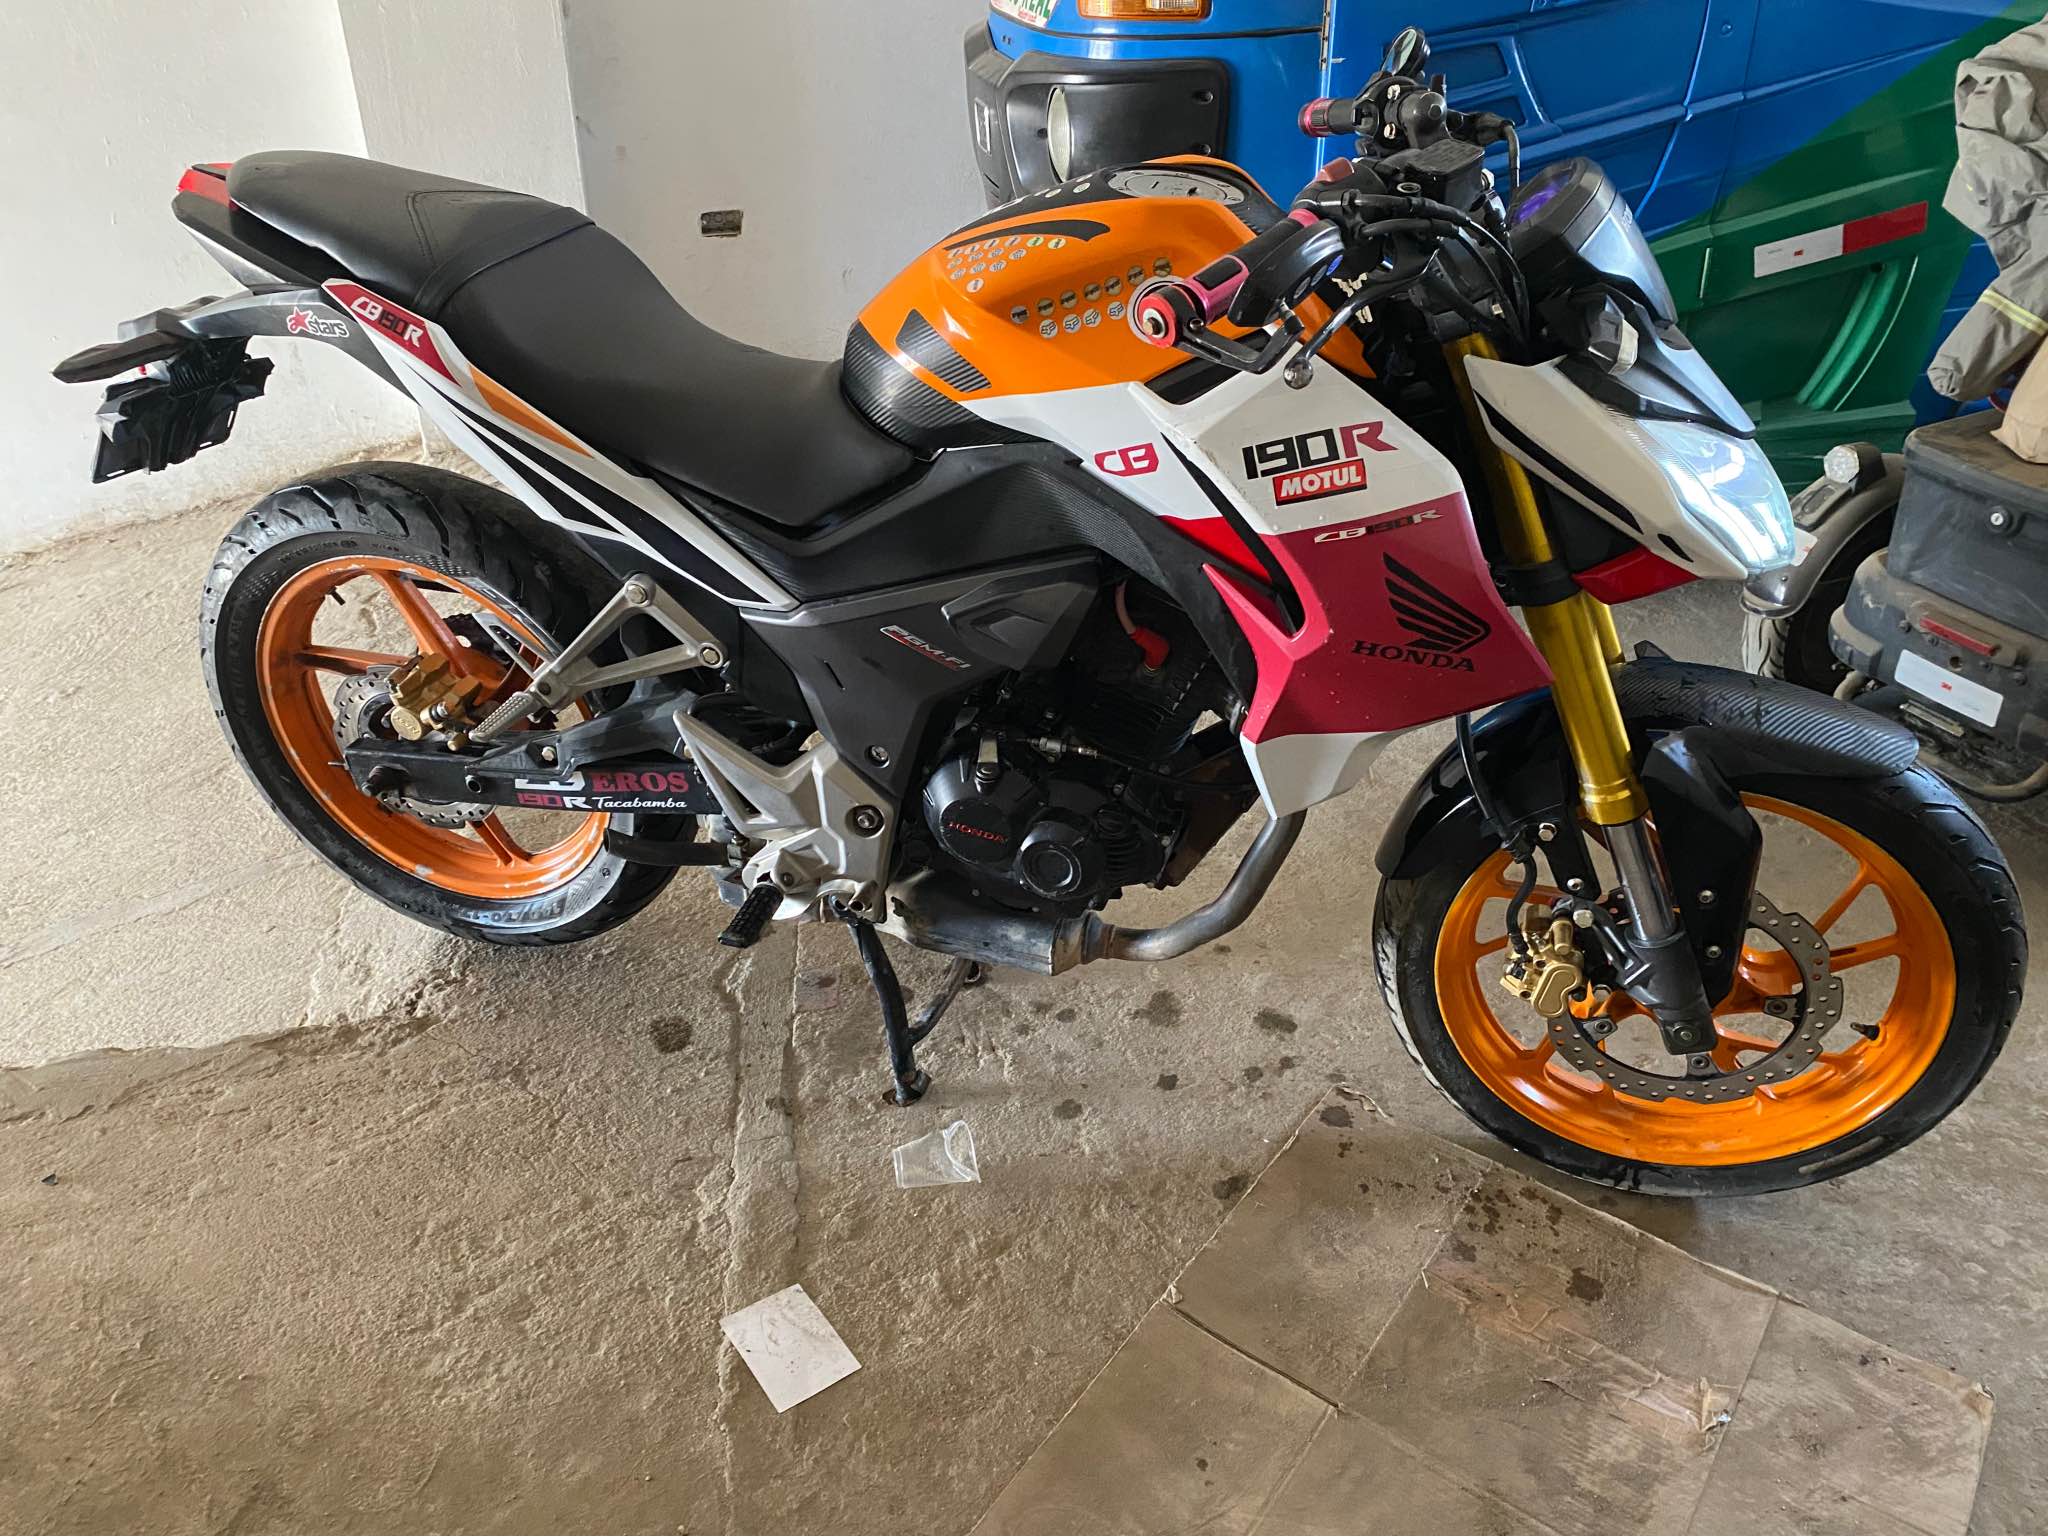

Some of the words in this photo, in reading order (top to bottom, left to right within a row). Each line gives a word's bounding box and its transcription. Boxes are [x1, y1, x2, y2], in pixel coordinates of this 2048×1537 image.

[1095, 443, 1159, 477] CB
[1242, 421, 1398, 479] 190R
[1279, 465, 1362, 498] MOTUL
[1352, 640, 1475, 672] HONDA
[590, 772, 689, 793] EROS
[516, 793, 592, 809] 190R
[592, 796, 688, 809] Tacabamba
[948, 821, 1008, 843] HONDA
